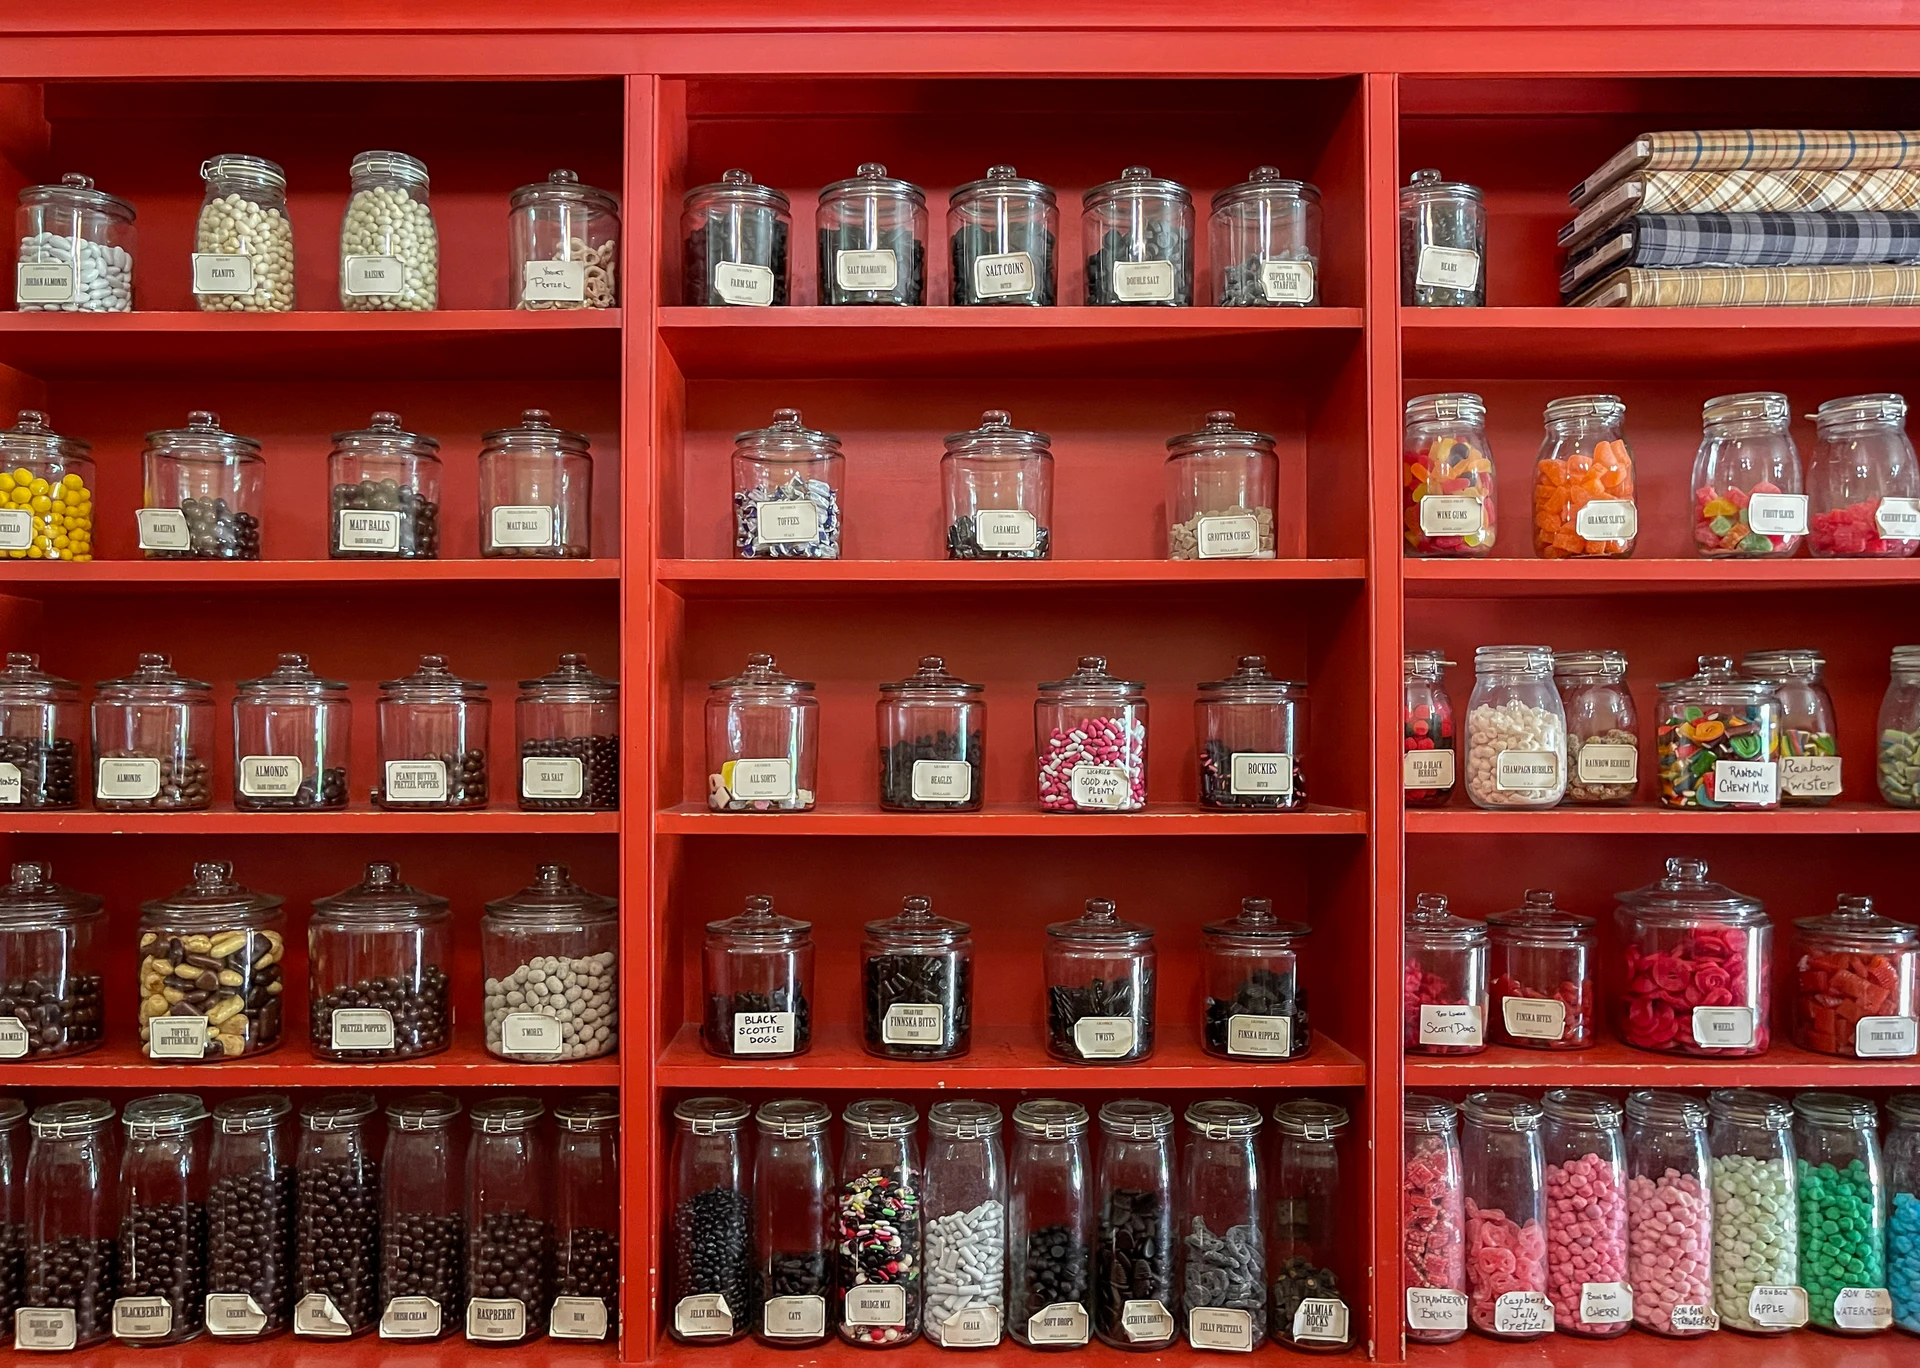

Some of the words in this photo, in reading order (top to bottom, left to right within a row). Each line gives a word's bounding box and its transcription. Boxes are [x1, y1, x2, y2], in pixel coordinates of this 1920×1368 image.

[847, 265, 860, 275] SALT
[861, 265, 887, 274] DIAMONDS
[985, 264, 1002, 277] SALT
[1003, 262, 1024, 275] COINS
[1441, 261, 1457, 272] BEARS
[212, 269, 235, 278] PEANUTS
[364, 270, 384, 279] RAISINS
[1269, 273, 1284, 281] SUPER
[1285, 273, 1300, 282] SALTY
[45, 278, 68, 287] ALMONDS
[731, 278, 744, 288] FARM
[745, 279, 757, 289] SALT
[1126, 277, 1146, 286] DOUBLE
[1147, 276, 1159, 284] SALT
[1273, 281, 1297, 290] STARFISH
[1437, 511, 1451, 519] WINE
[1452, 511, 1467, 520] GUMS
[777, 517, 800, 526] TOFFEES
[1587, 516, 1608, 525] ORANGE
[349, 519, 368, 530] MALT
[368, 520, 390, 532] BALLS
[507, 522, 521, 530] MALT
[522, 522, 538, 530] BALLS
[993, 525, 1020, 534] CARAMELS
[1234, 531, 1251, 540] CUBES
[1413, 761, 1422, 769] RED
[1423, 761, 1428, 769] &
[1428, 760, 1442, 769] BLACK
[1585, 759, 1609, 768] RAINBOW
[1609, 759, 1630, 768] BERRIES
[255, 765, 288, 777] ALMONDS
[1248, 763, 1277, 775] ROCKIES
[1418, 769, 1438, 777] BERRIES
[1502, 765, 1531, 774] CHAMPAGN
[1531, 766, 1554, 774] BUBBLES
[117, 774, 141, 782] ALMONDS
[396, 772, 416, 780] PEANUT
[417, 772, 437, 781] BUTTER
[541, 773, 551, 781] SEA
[552, 773, 564, 782] SALT
[750, 775, 760, 783] ALL
[761, 774, 777, 783] SORTS
[931, 776, 952, 784] BEAGLES
[394, 780, 416, 788] PRETZEL
[417, 780, 439, 789] POPPERS
[1080, 778, 1100, 787] GOOD
[1103, 779, 1119, 787] AND
[1719, 779, 1749, 793] CHEWY
[1752, 781, 1769, 792] MIX
[1781, 775, 1834, 790] Twister
[1088, 786, 1114, 795] PLENTY
[745, 1015, 777, 1024] BLACK
[890, 1016, 917, 1027] FINNSKA
[918, 1017, 937, 1028] BITES
[1516, 1012, 1535, 1022] FINSKA
[1536, 1014, 1552, 1023] BITES
[340, 1023, 363, 1032] PRETZEL
[364, 1024, 387, 1033] POPPERS
[739, 1025, 784, 1035] SCOTTIE
[1713, 1022, 1734, 1031] WHEELS
[749, 1036, 777, 1044] DOGS
[1095, 1032, 1115, 1041] TWISTS
[1238, 1030, 1257, 1040] FINSKA
[1258, 1031, 1280, 1041] RIPPLES
[1870, 1032, 1883, 1040] TIRE
[1884, 1031, 1904, 1040] TRACKS
[860, 1300, 879, 1309] BRIDGE
[880, 1300, 891, 1309] MIX
[1754, 1304, 1784, 1314] APPLE
[121, 1306, 164, 1318] BLACKBERRY
[409, 1312, 428, 1321] CREAM
[477, 1308, 517, 1321] RASPBERRY
[690, 1309, 706, 1318] JELLY
[706, 1309, 721, 1318] BELLY
[788, 1312, 801, 1320] CATS
[1511, 1307, 1538, 1320] Jelly
[574, 1313, 585, 1321] RUM
[1306, 1315, 1328, 1327] ROCKS
[963, 1321, 980, 1330] CHALK
[1043, 1318, 1056, 1327] SOFT
[1057, 1317, 1074, 1327] DROPS
[1502, 1319, 1545, 1330] Pretzel
[1200, 1323, 1216, 1332] JELLY
[1216, 1324, 1242, 1334] PRETZELS
